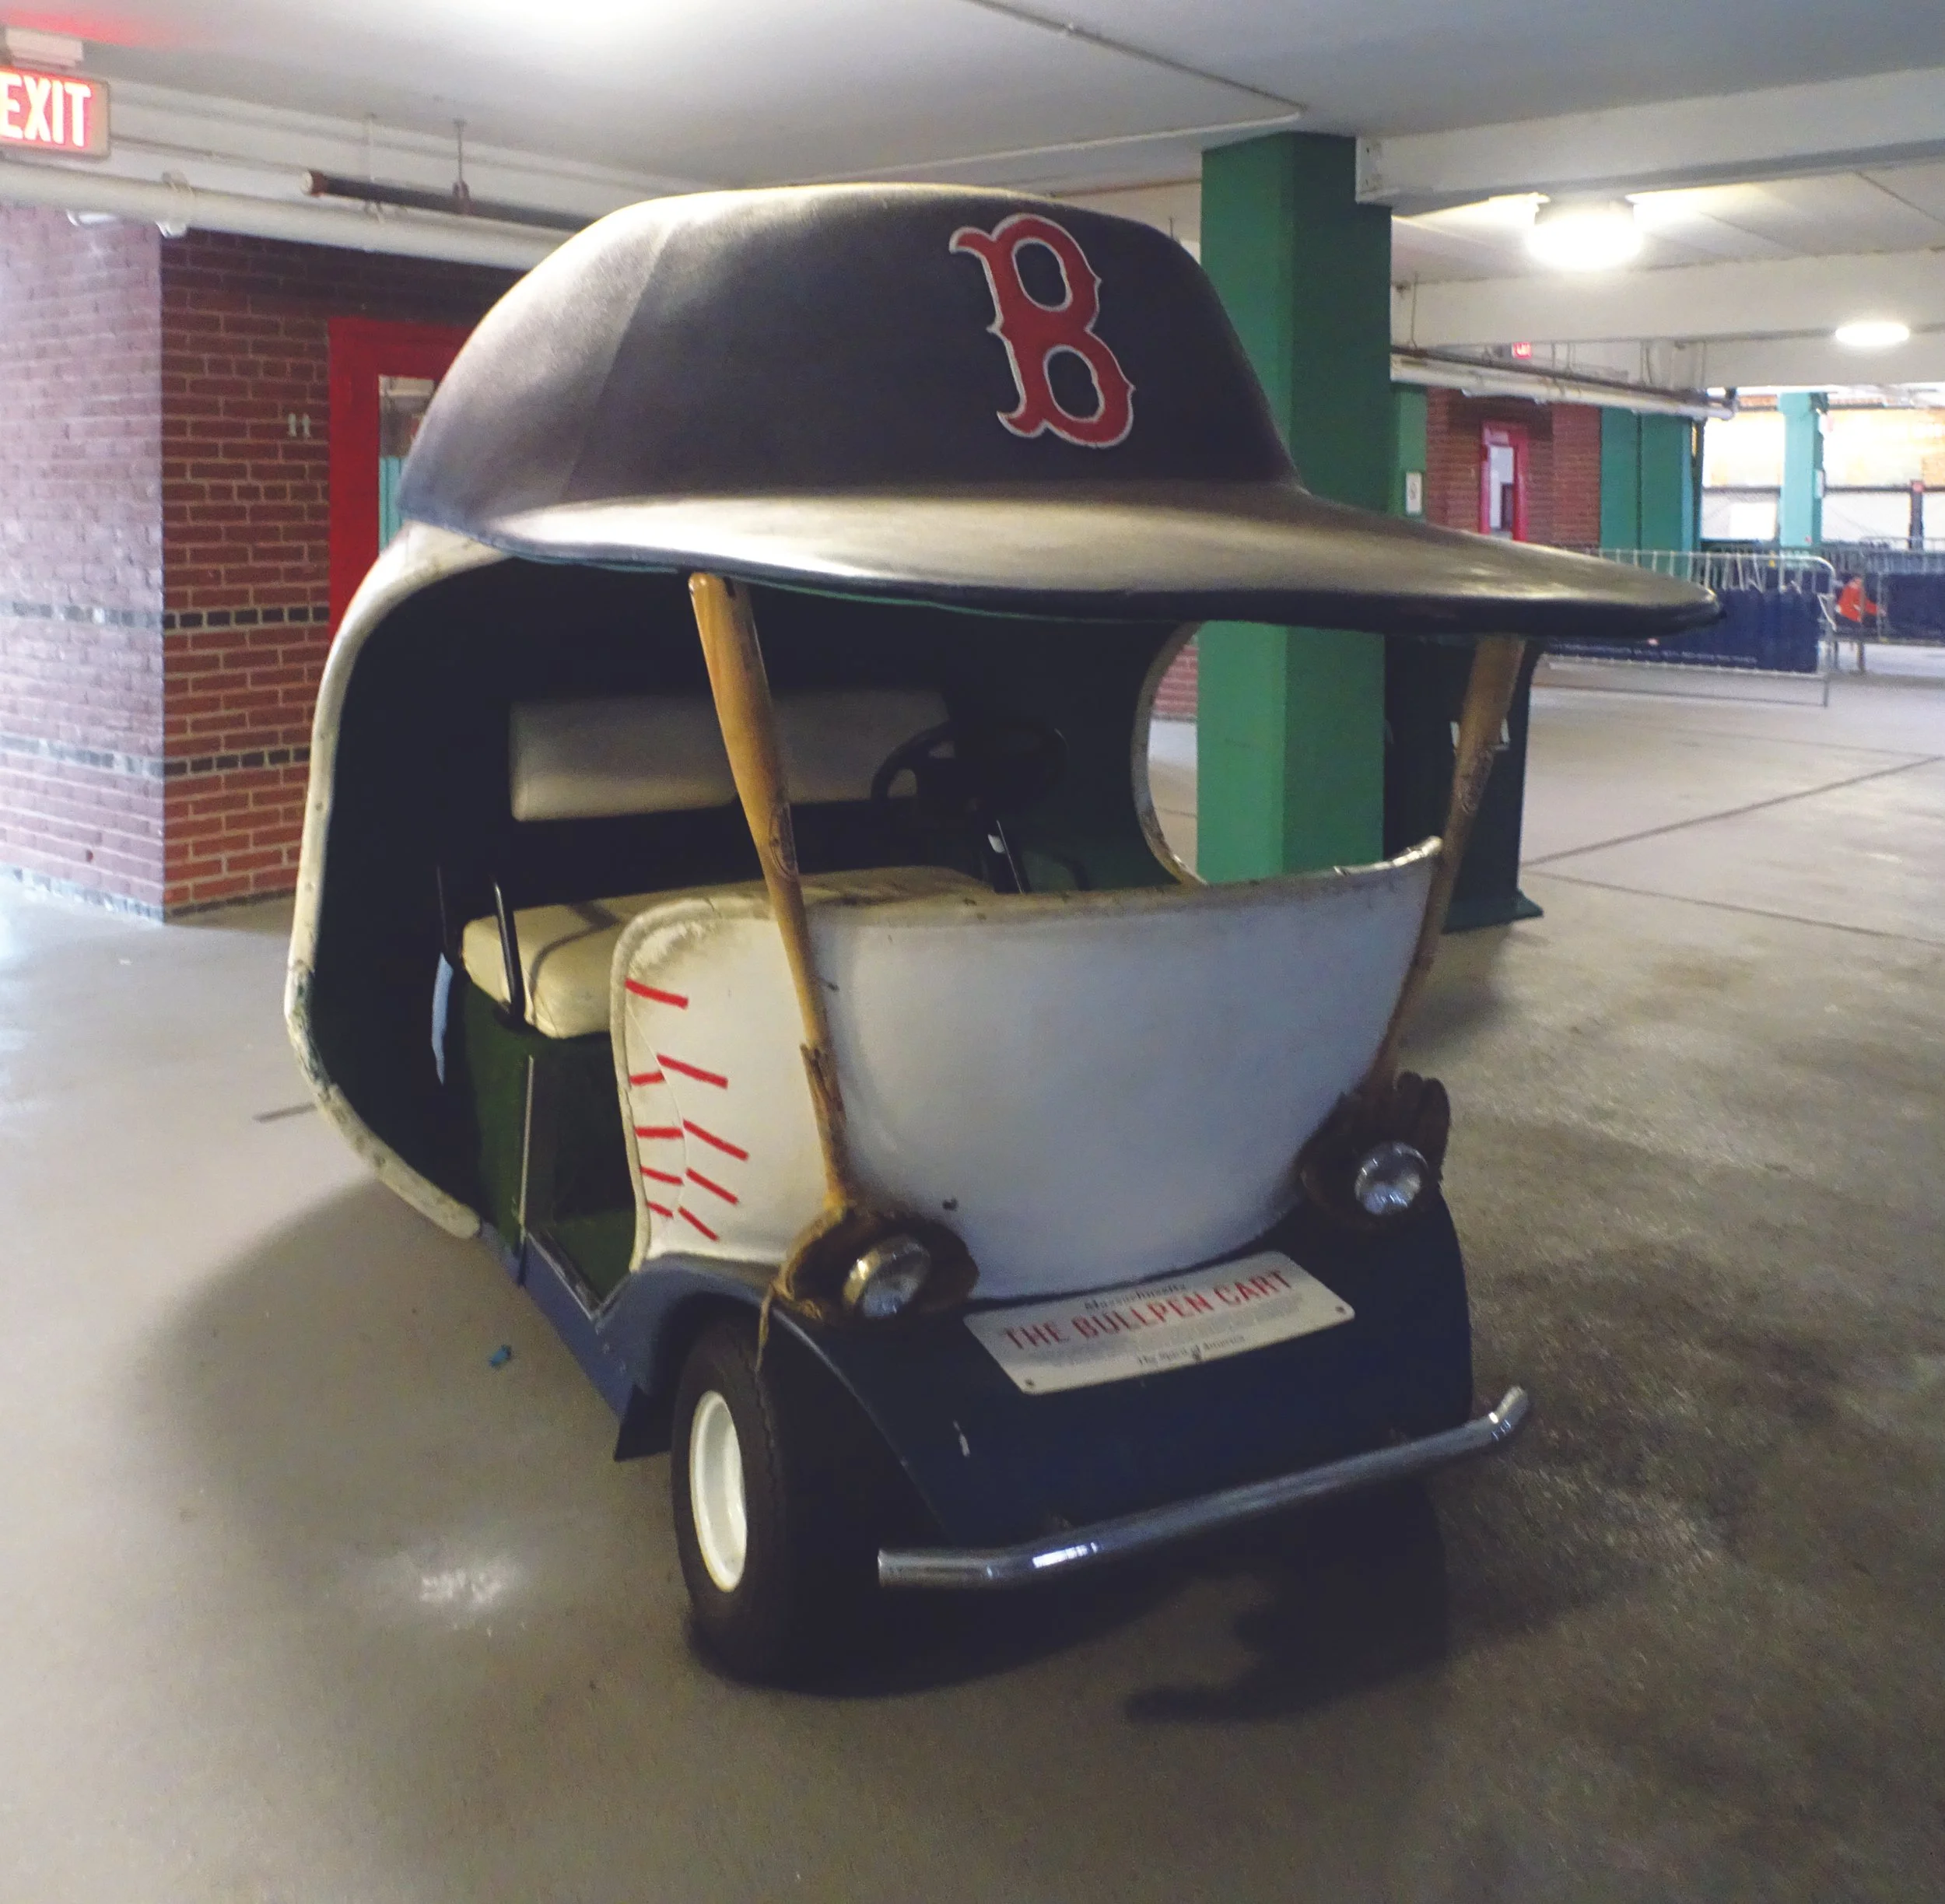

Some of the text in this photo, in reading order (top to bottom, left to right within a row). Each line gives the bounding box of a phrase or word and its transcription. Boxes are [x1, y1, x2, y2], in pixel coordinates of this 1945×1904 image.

[0, 73, 91, 147] EXIT
[949, 212, 1136, 449] B
[1004, 1269, 1292, 1350] THE BULLPEN CART
